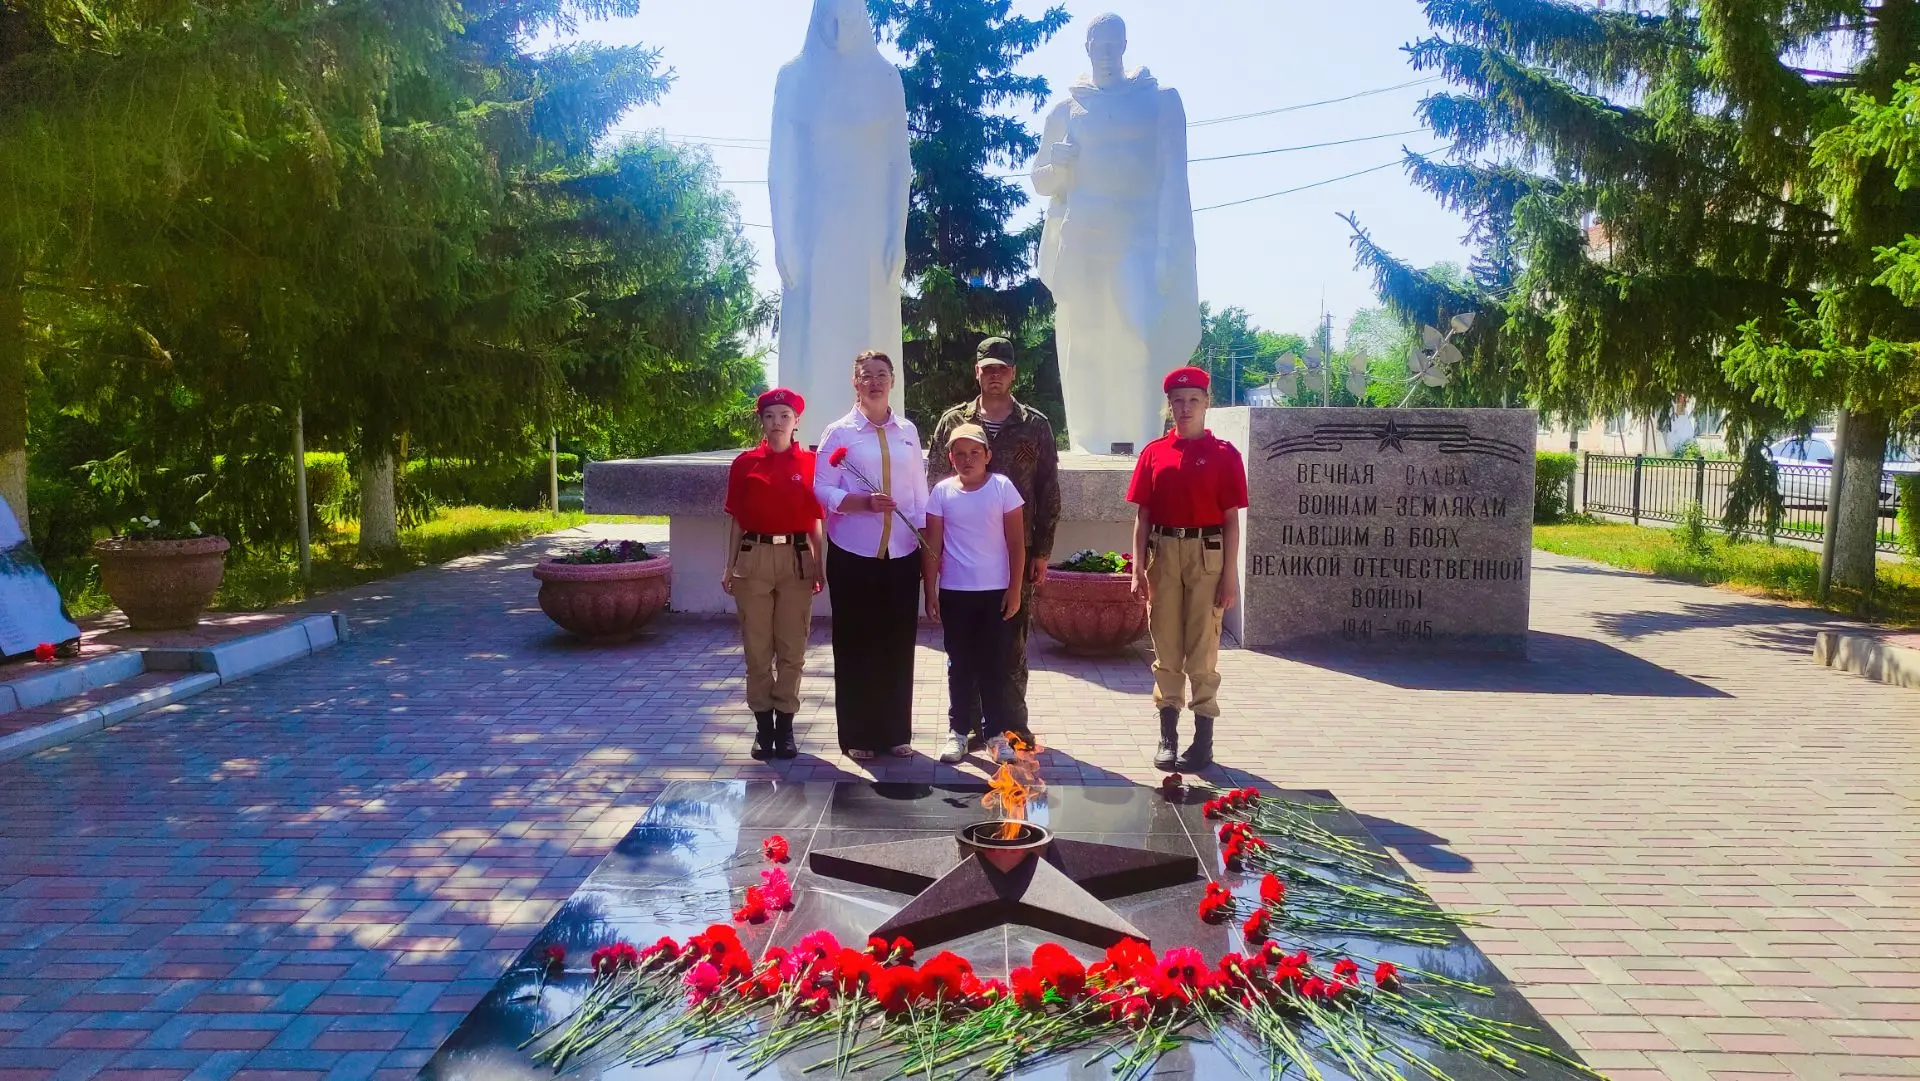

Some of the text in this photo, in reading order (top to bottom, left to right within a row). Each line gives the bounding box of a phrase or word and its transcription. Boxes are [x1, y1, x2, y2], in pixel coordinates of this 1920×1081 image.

[1297, 463, 1470, 486] ВЕЧНАЯ СЛАВА
[1282, 525, 1461, 548] ПАВШИМ В БОЯХ
[1252, 554, 1524, 581] ВЕЛИКОЙ ОТЕЧЕСТВЕННОЙ
[1352, 587, 1423, 610] ВОЙНЫ
